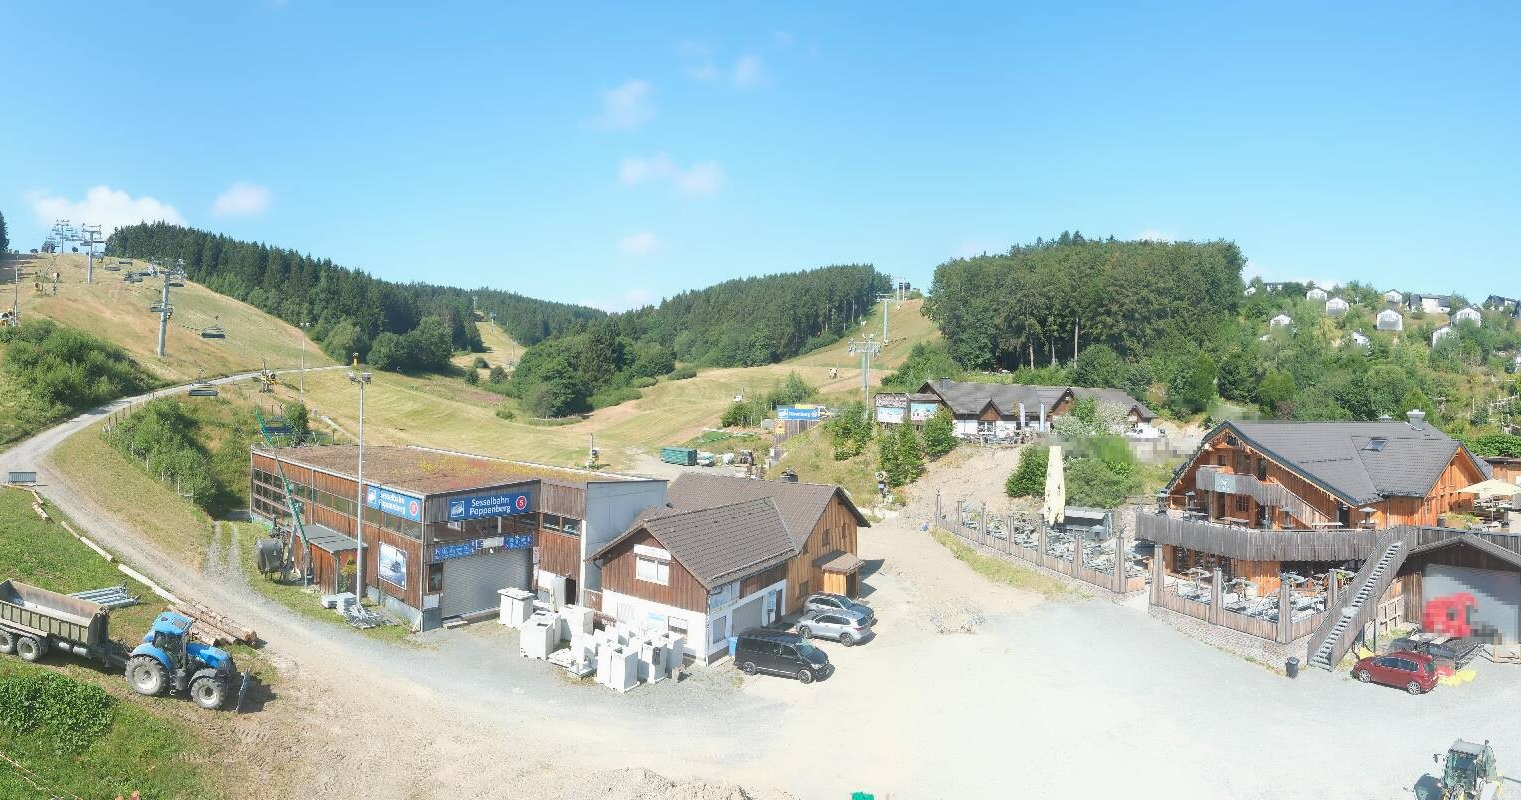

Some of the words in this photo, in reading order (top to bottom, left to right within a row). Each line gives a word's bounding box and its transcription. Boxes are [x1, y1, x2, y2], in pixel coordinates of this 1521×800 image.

[471, 496, 510, 507] Sesselbahn
[519, 499, 524, 507] 5
[469, 505, 511, 517] Poppenberg
